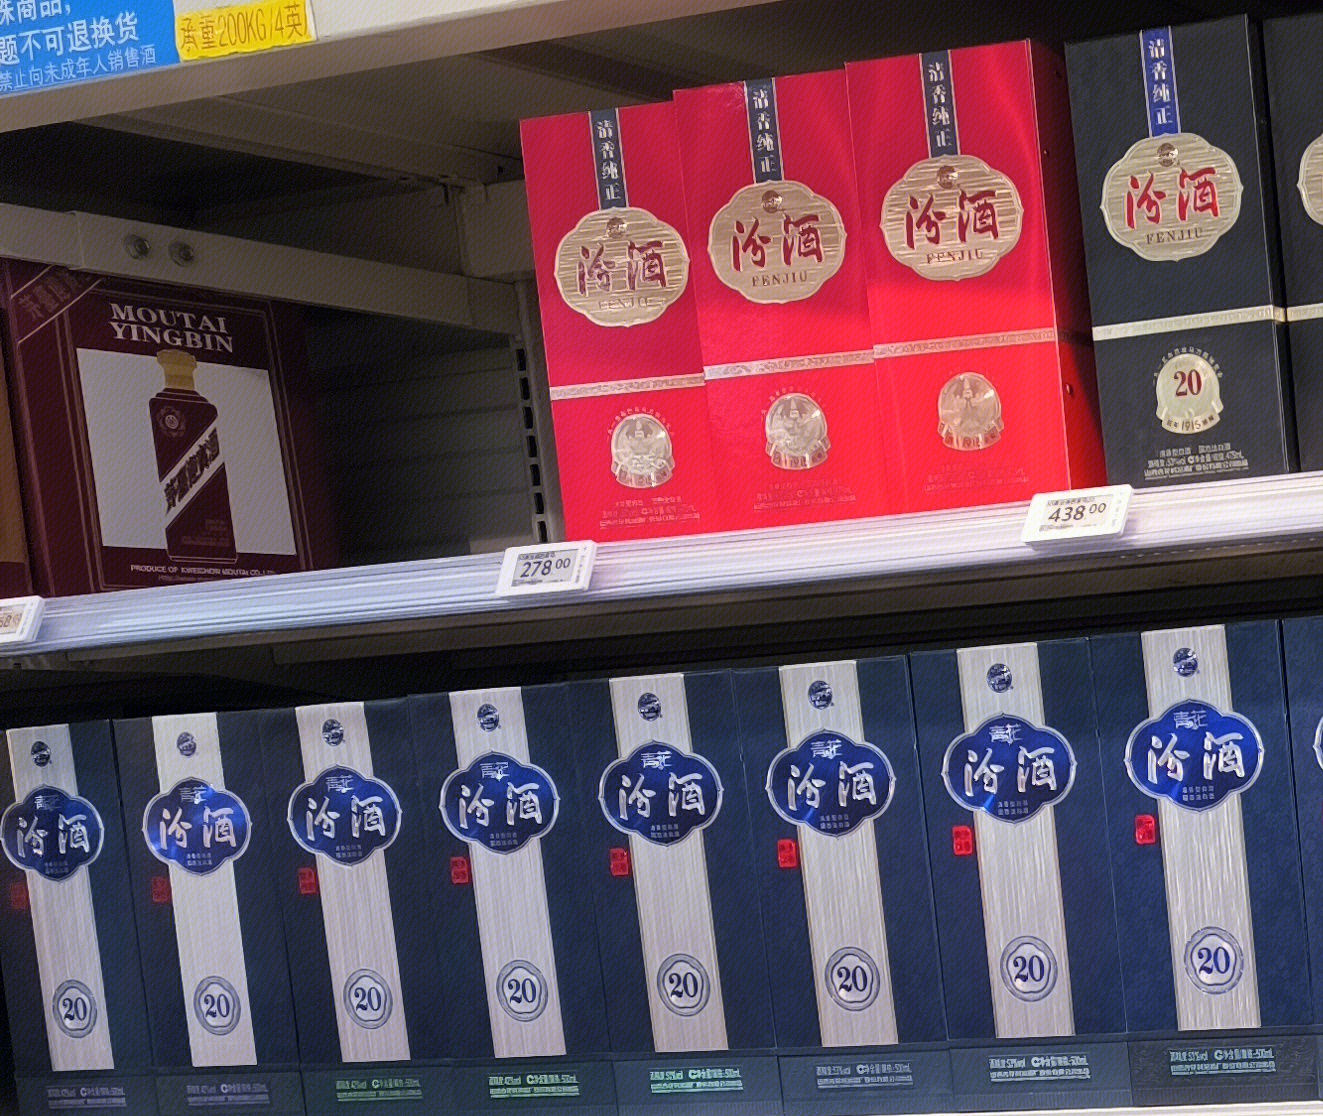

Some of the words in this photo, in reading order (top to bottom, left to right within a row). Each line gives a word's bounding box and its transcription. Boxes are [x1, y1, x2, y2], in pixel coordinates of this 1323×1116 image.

[179, 2, 308, 53] 承重200KG/4英
[1124, 167, 1220, 229] 汾酒
[905, 189, 998, 250] 汾酒
[1145, 227, 1204, 245] FENJIU
[732, 213, 823, 271] 汾酒
[577, 240, 667, 297] 汾酒
[751, 270, 808, 288] FENJIU
[109, 302, 228, 335] MOUTAI
[110, 321, 234, 354] YINGBIN
[1173, 369, 1203, 397] 20
[964, 746, 1058, 796] 汾酒
[1146, 731, 1245, 783] 汾酒
[618, 771, 706, 820] 汾酒
[786, 760, 877, 811] 汾酒
[305, 794, 387, 841] 汾酒
[458, 781, 543, 829] 汾酒
[16, 812, 90, 858] 汾酒
[160, 806, 238, 850] 汾酒
[837, 966, 868, 993] 20
[1013, 955, 1046, 982] 20
[1197, 947, 1231, 974] 20
[353, 986, 381, 1012] 20
[507, 978, 537, 1003] 20
[668, 972, 699, 998] 20
[62, 997, 87, 1022] 20
[203, 993, 230, 1018] 20
